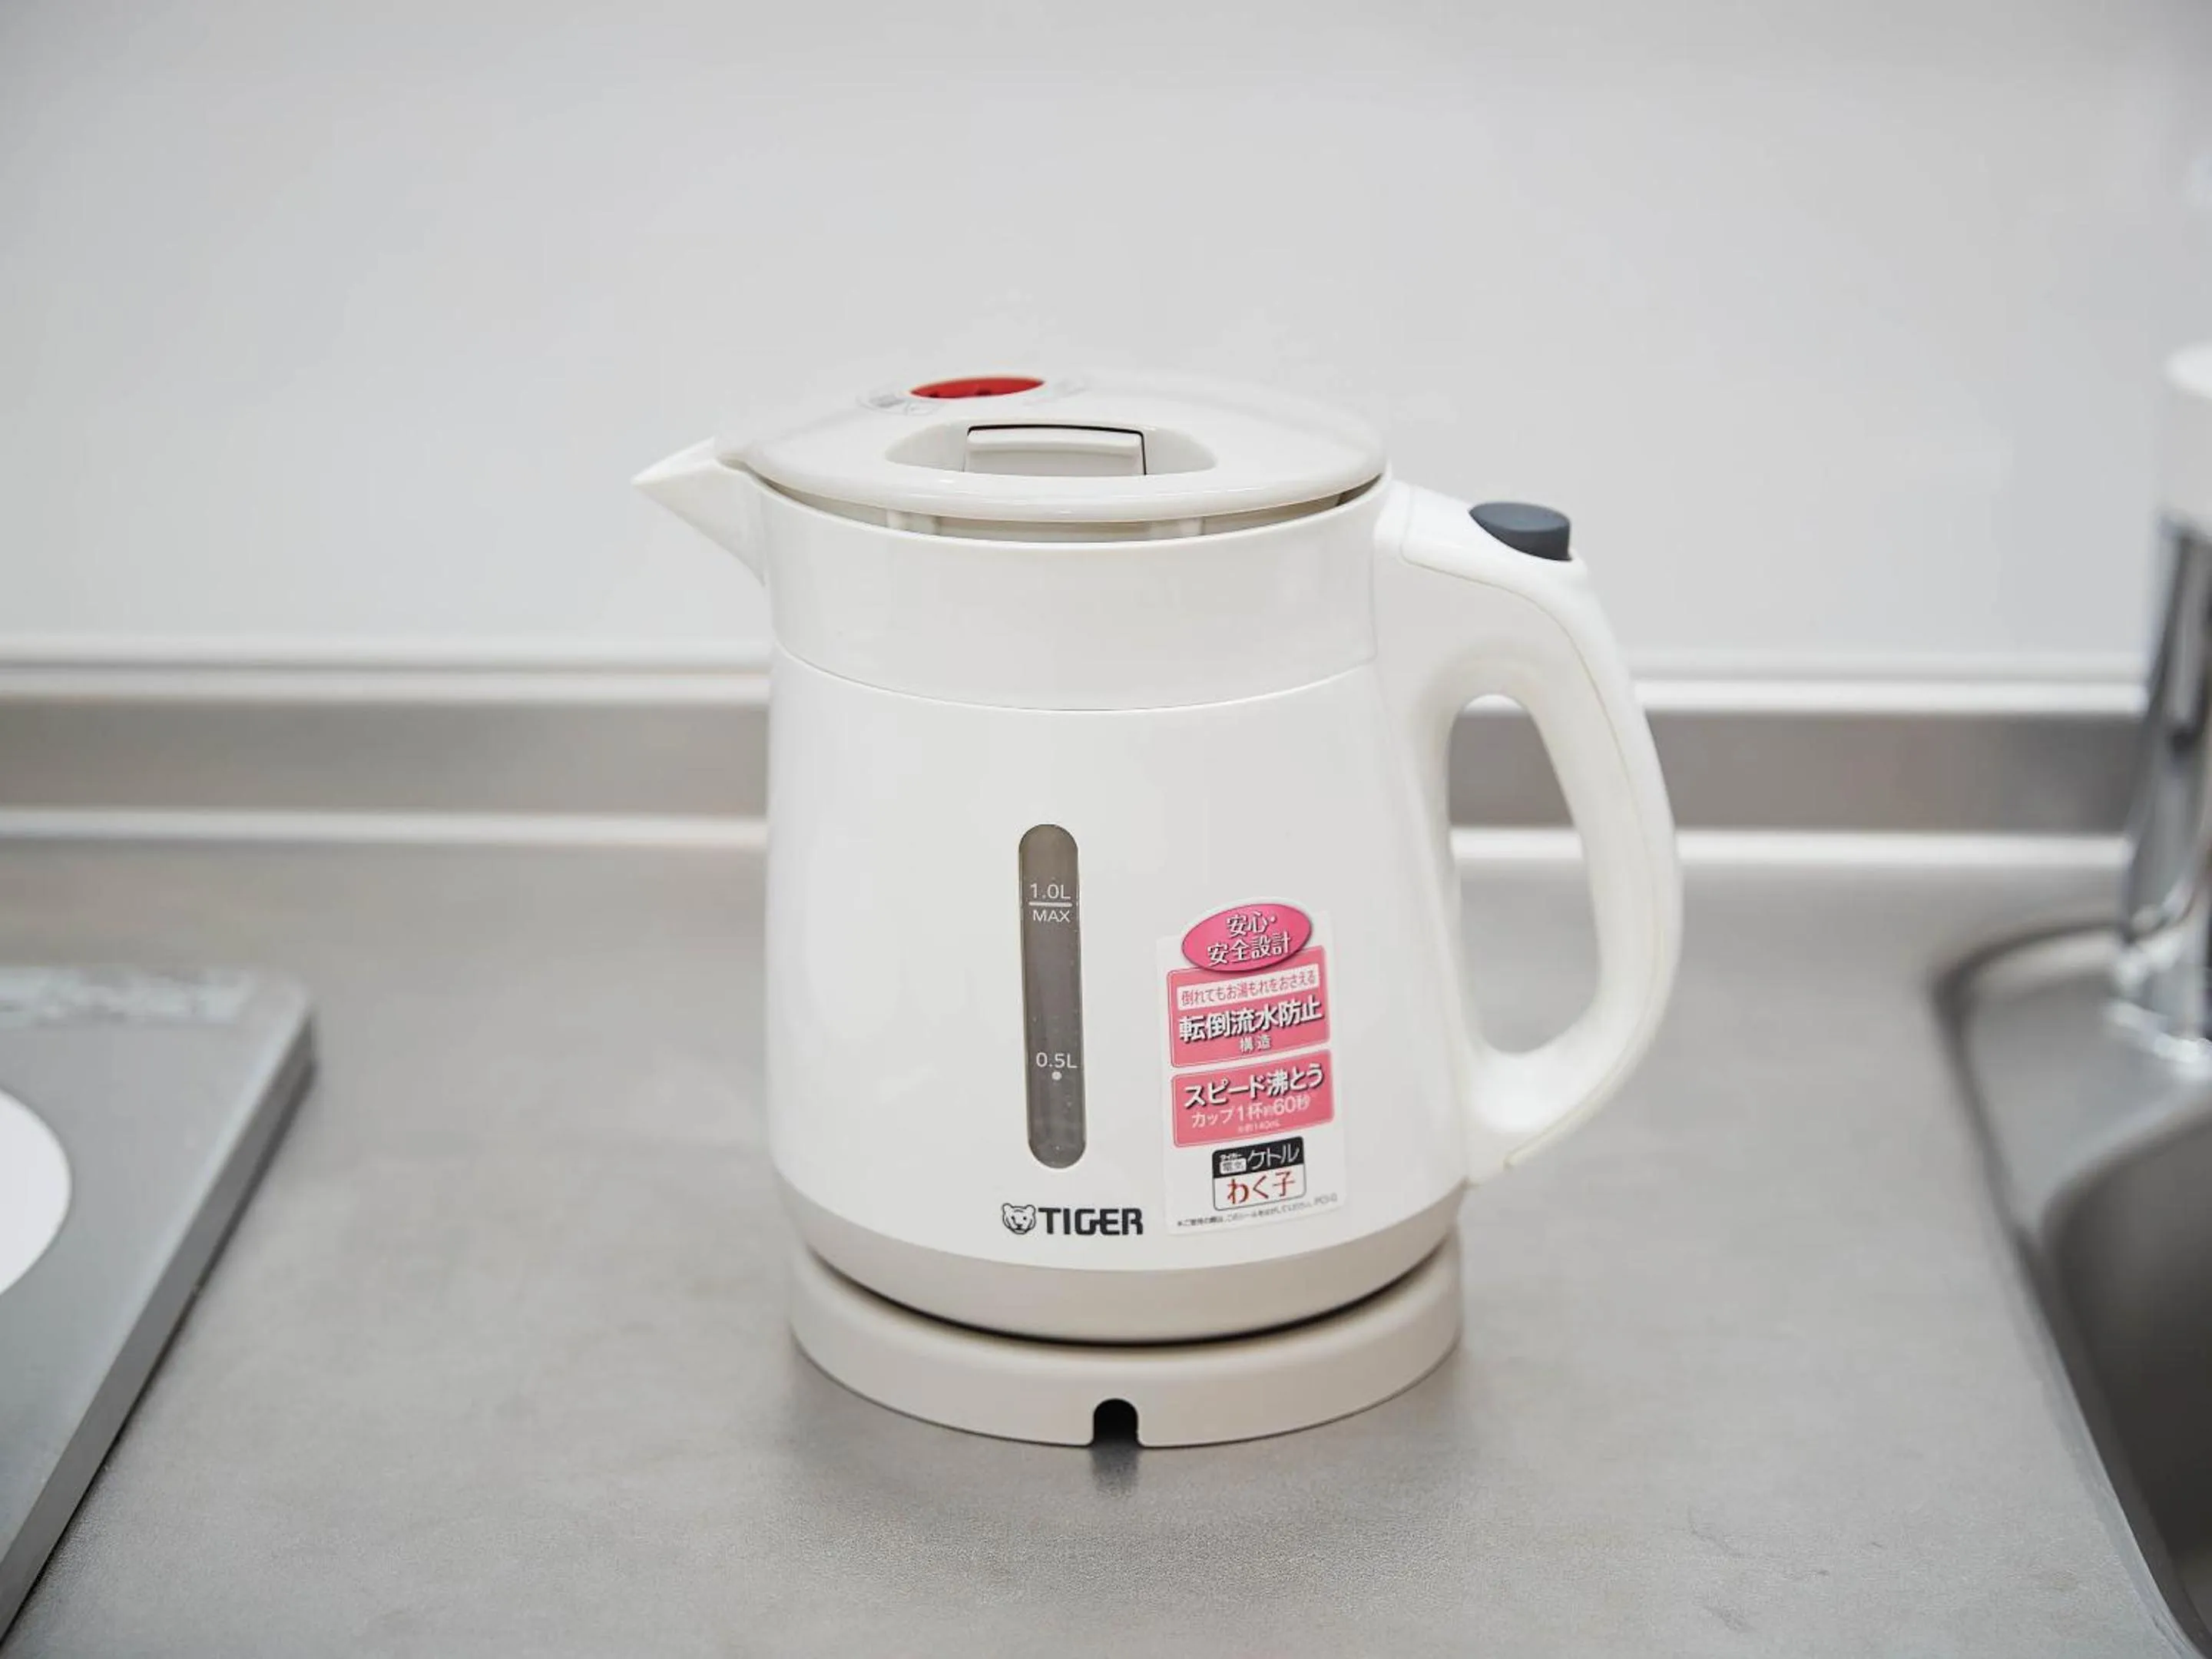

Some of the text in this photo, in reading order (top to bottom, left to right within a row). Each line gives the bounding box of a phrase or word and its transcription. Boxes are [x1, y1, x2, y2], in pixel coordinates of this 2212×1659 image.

[1029, 882, 1071, 901] 1.0L
[1032, 909, 1071, 923] MAX
[1207, 932, 1291, 966] 安全設計
[1181, 970, 1316, 1006] 倒れてもお湯もれをおさえる
[1179, 995, 1323, 1043] 転倒流水防止
[1239, 1035, 1271, 1053] 構造
[1035, 1051, 1078, 1068] 0.5L
[1184, 1063, 1323, 1108] スピード沸とう
[1247, 1144, 1300, 1171] ケトル
[1227, 1171, 1296, 1204] わく子
[1038, 1207, 1144, 1235] TIGER
